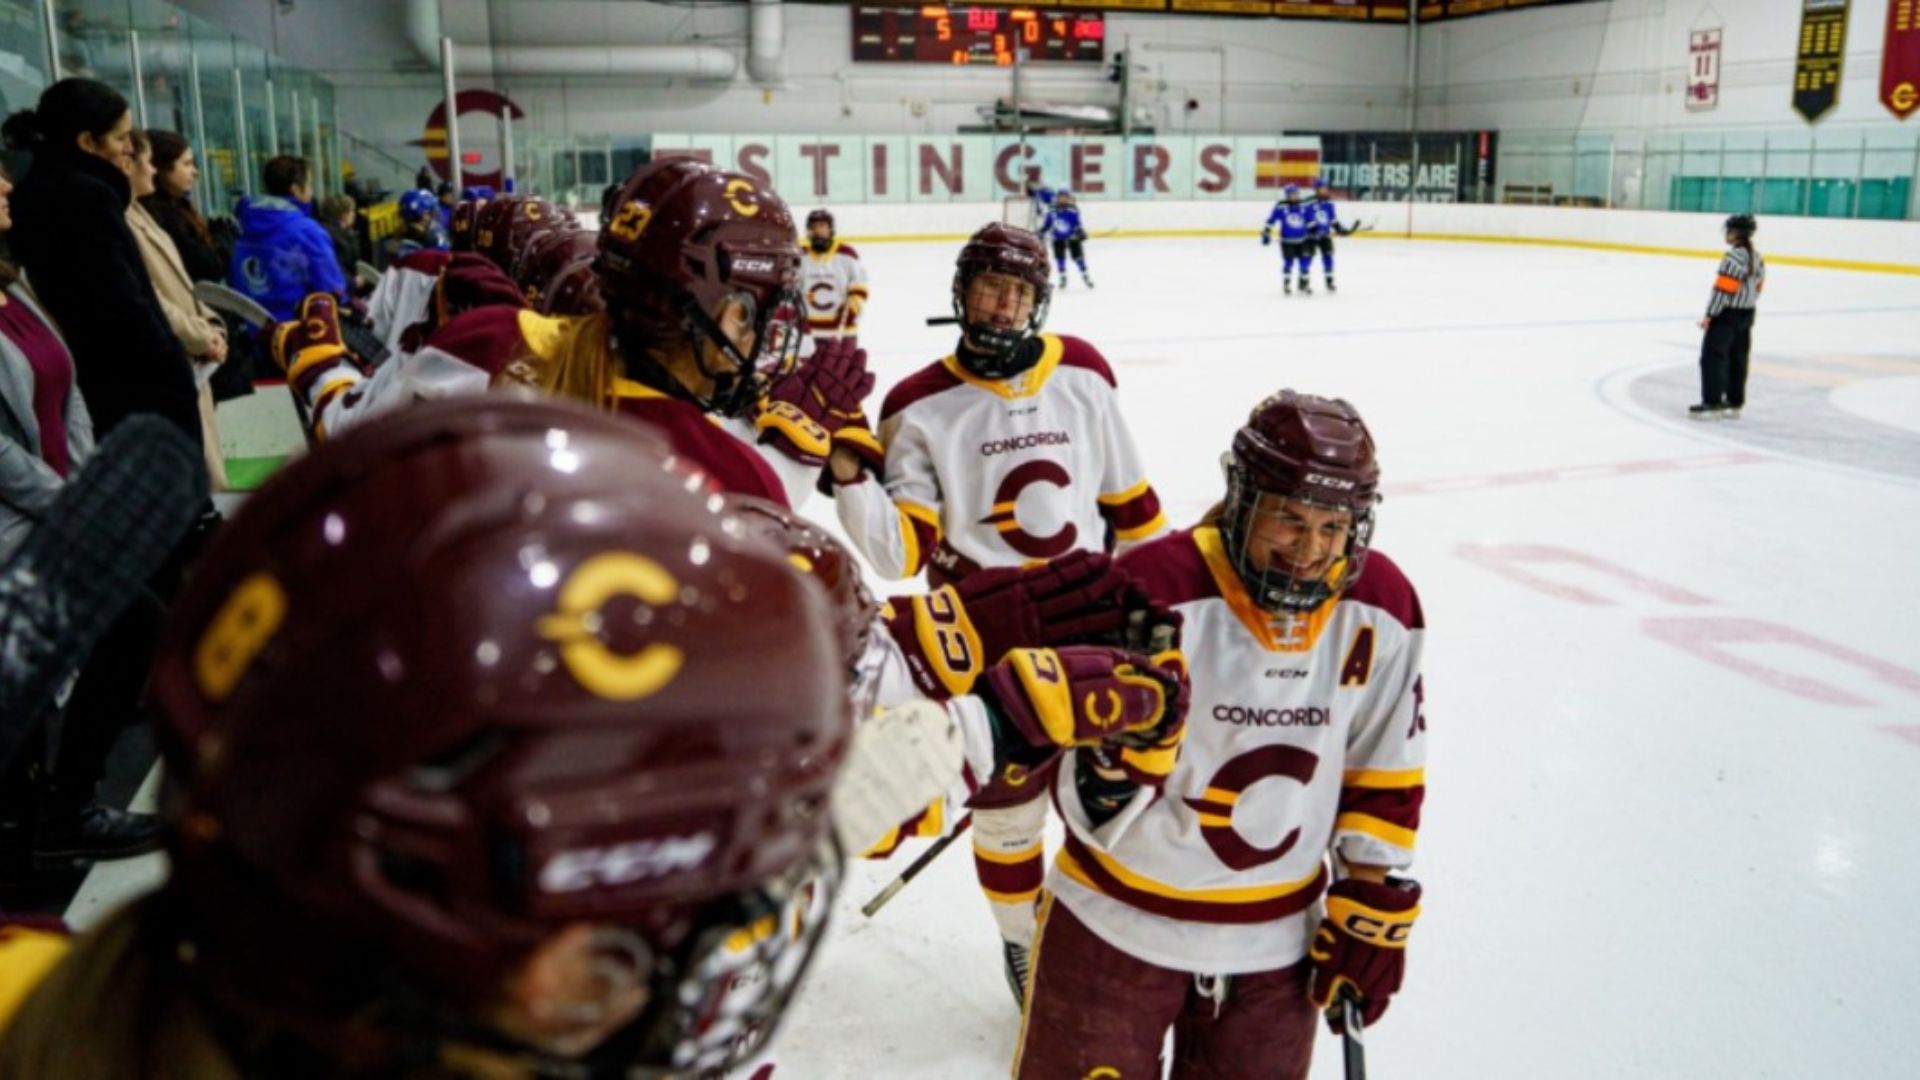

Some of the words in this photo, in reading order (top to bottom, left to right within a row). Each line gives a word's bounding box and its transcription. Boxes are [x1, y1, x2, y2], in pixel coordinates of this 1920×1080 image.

[937, 18, 951, 40] 5
[1024, 20, 1039, 42] 0
[737, 144, 1233, 194] STINGERS
[1415, 163, 1456, 188] ARE
[609, 200, 652, 243] 23
[731, 258, 774, 274] CCM
[981, 430, 1071, 457] CONCORDIA
[1305, 472, 1355, 490] CCM
[1338, 625, 1377, 687] A
